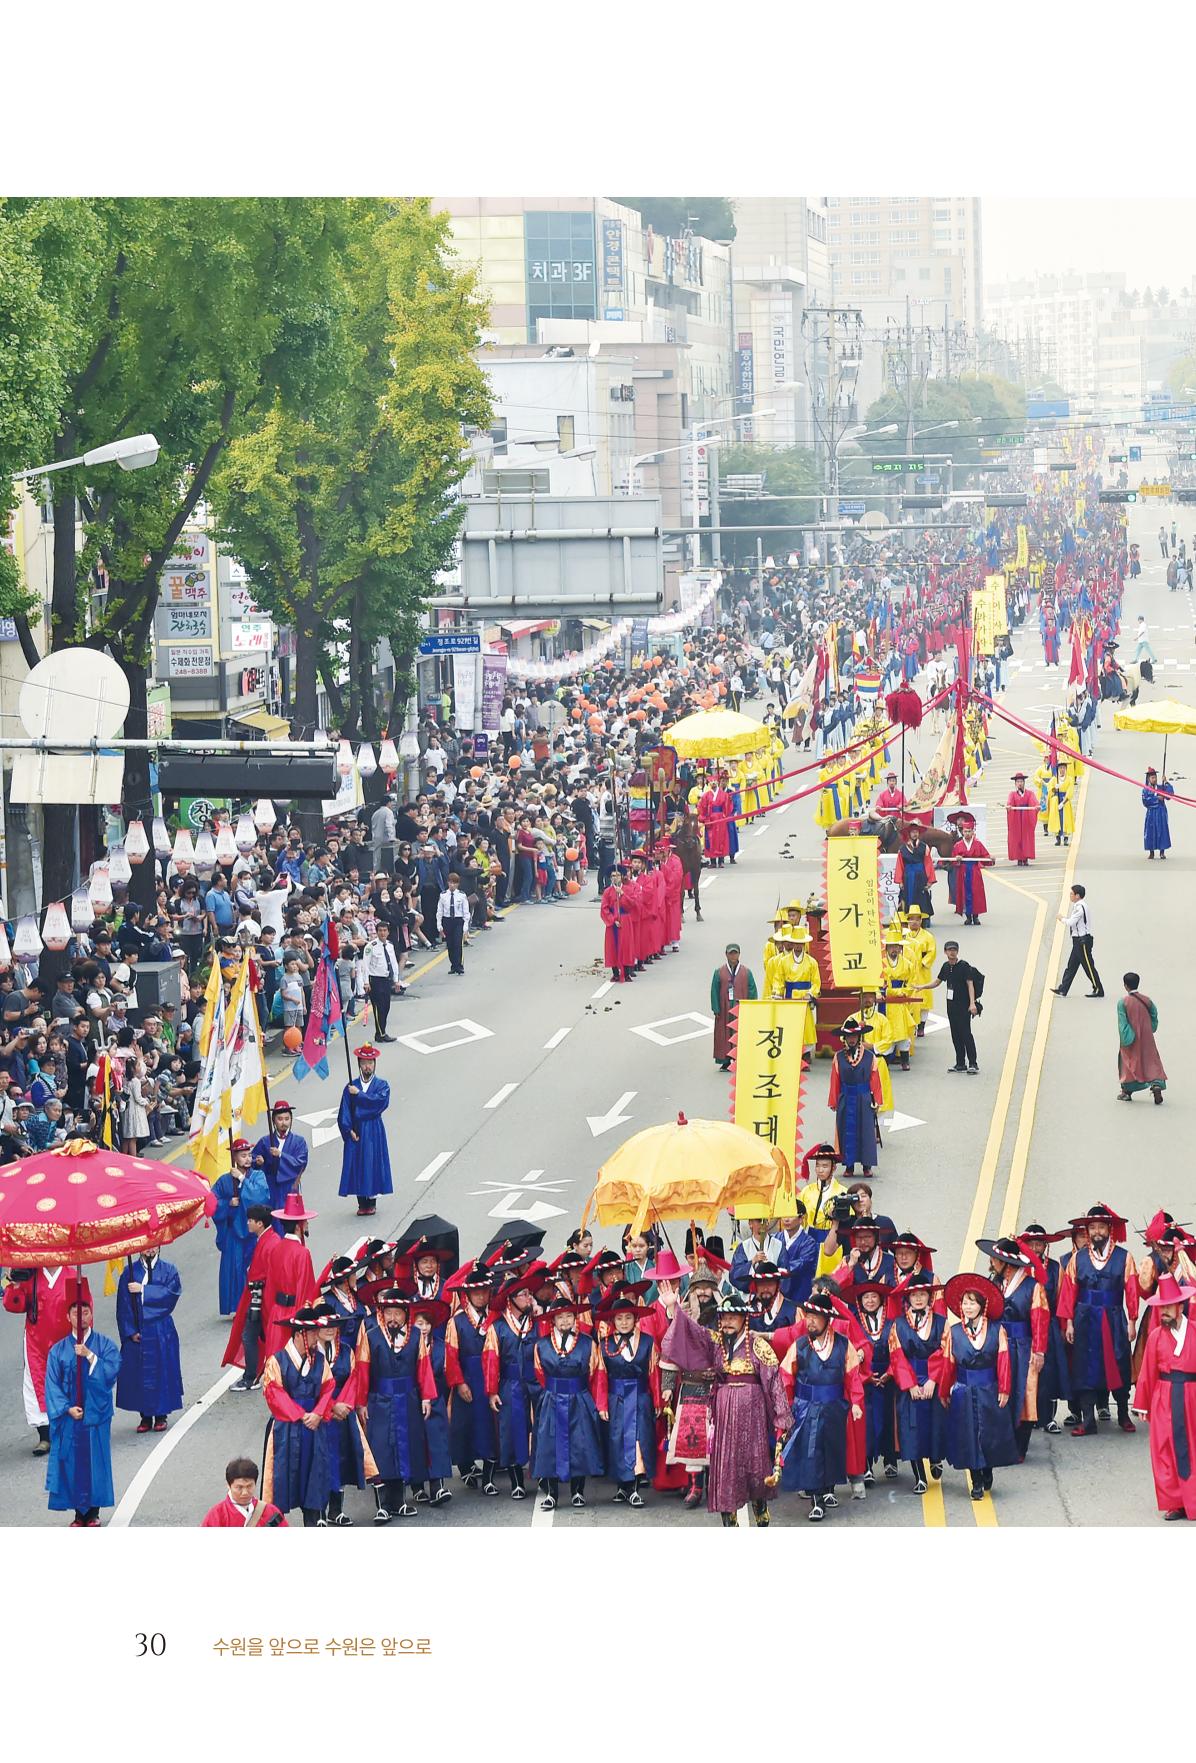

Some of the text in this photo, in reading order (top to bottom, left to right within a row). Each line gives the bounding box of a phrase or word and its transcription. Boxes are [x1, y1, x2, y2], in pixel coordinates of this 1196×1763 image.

[531, 260, 592, 282] 치과 3F
[169, 576, 208, 600] 꿀 맥주
[170, 620, 207, 636] 잔치국수
[171, 656, 211, 667] 수제화 전문점
[193, 803, 211, 822] 장
[865, 879, 875, 906] 임금이
[837, 855, 867, 972] 정가교
